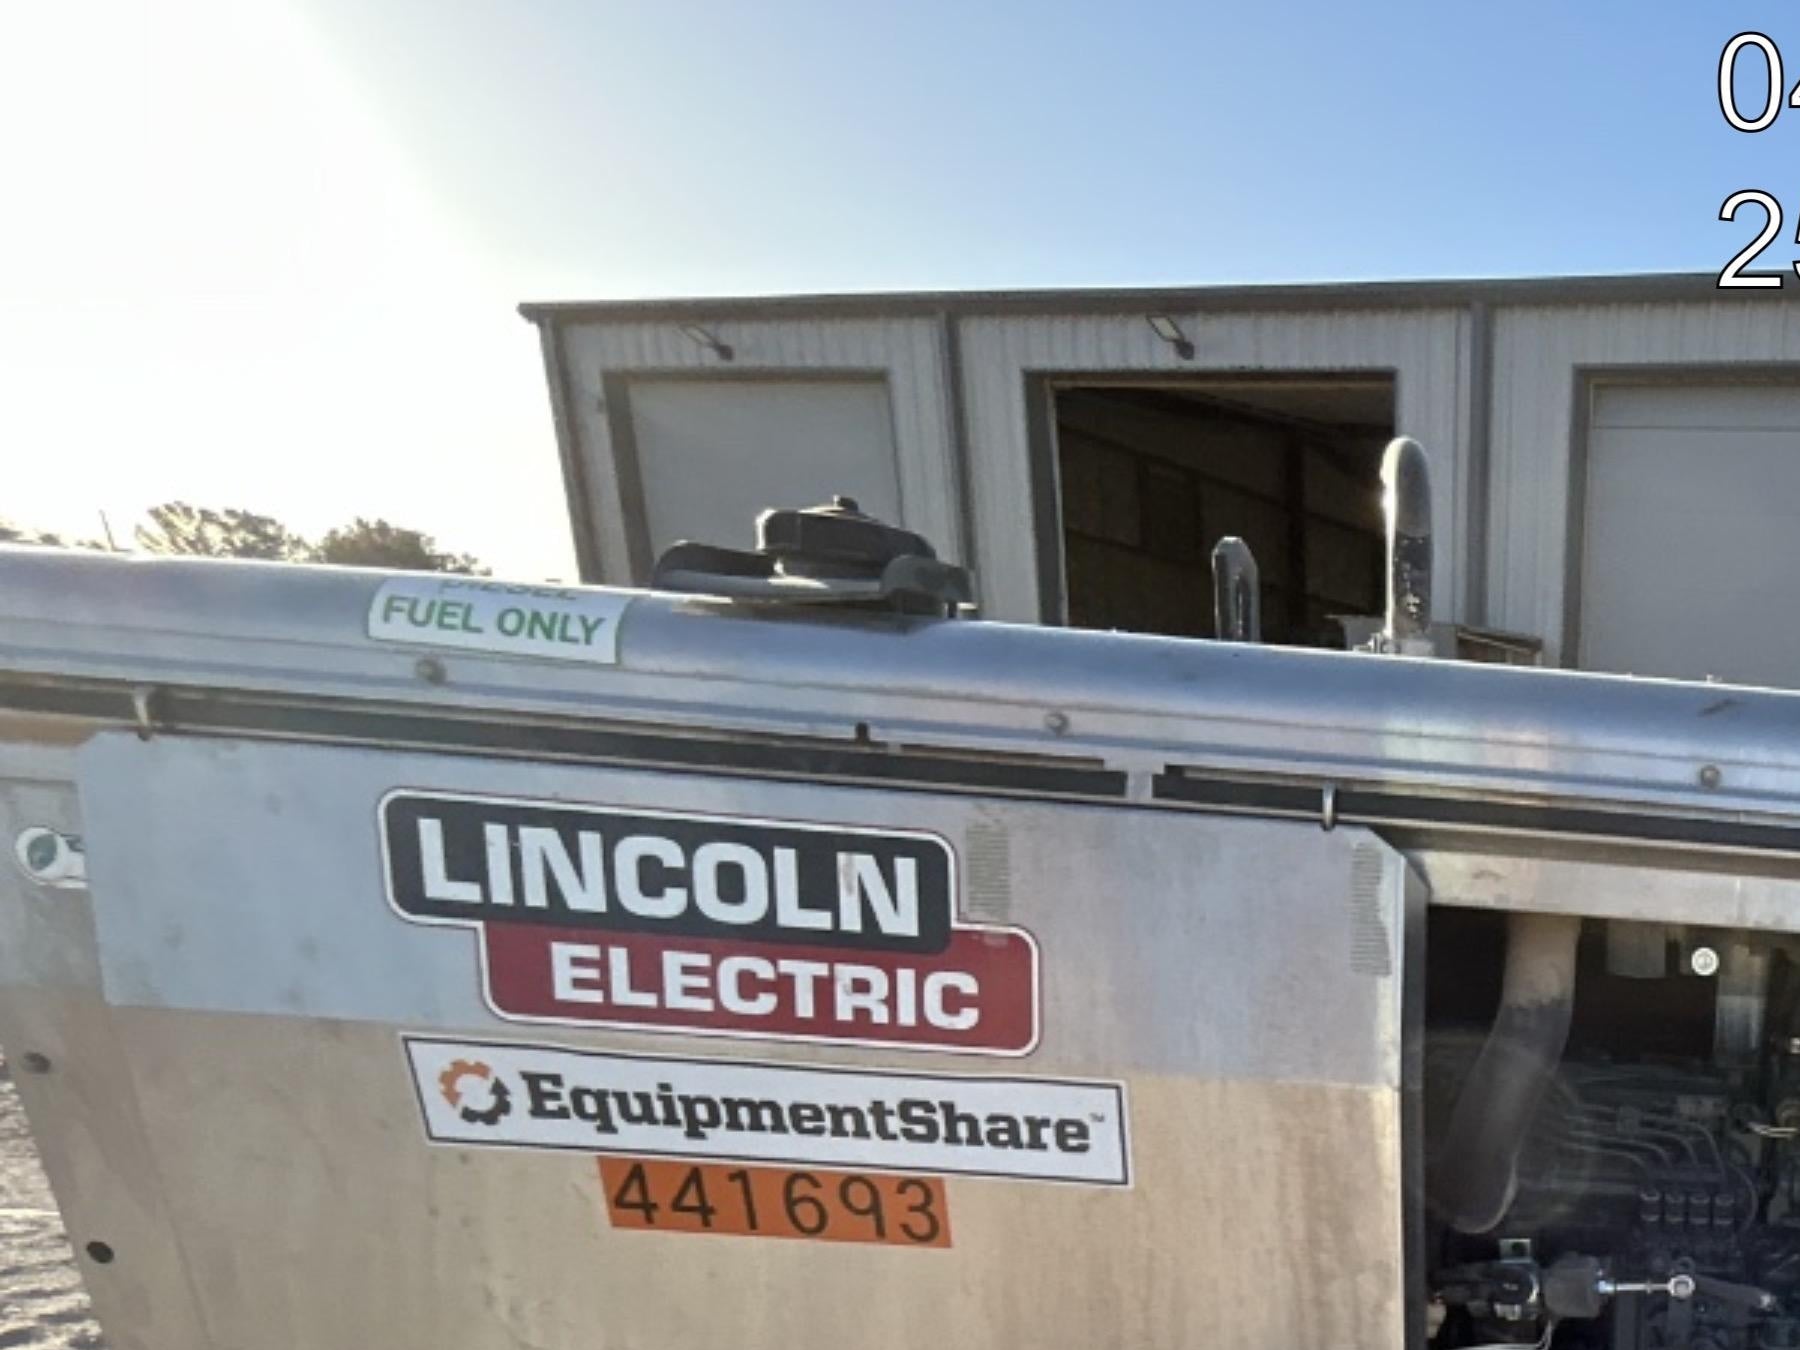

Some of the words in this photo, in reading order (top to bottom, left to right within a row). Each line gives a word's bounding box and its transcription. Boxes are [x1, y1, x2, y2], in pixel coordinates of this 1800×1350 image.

[383, 595, 484, 634] FUEL
[497, 608, 606, 646] ONLY
[416, 817, 923, 938] LINCOLN
[549, 940, 980, 1030] ELECTRIC
[613, 1162, 942, 1244] 441693
